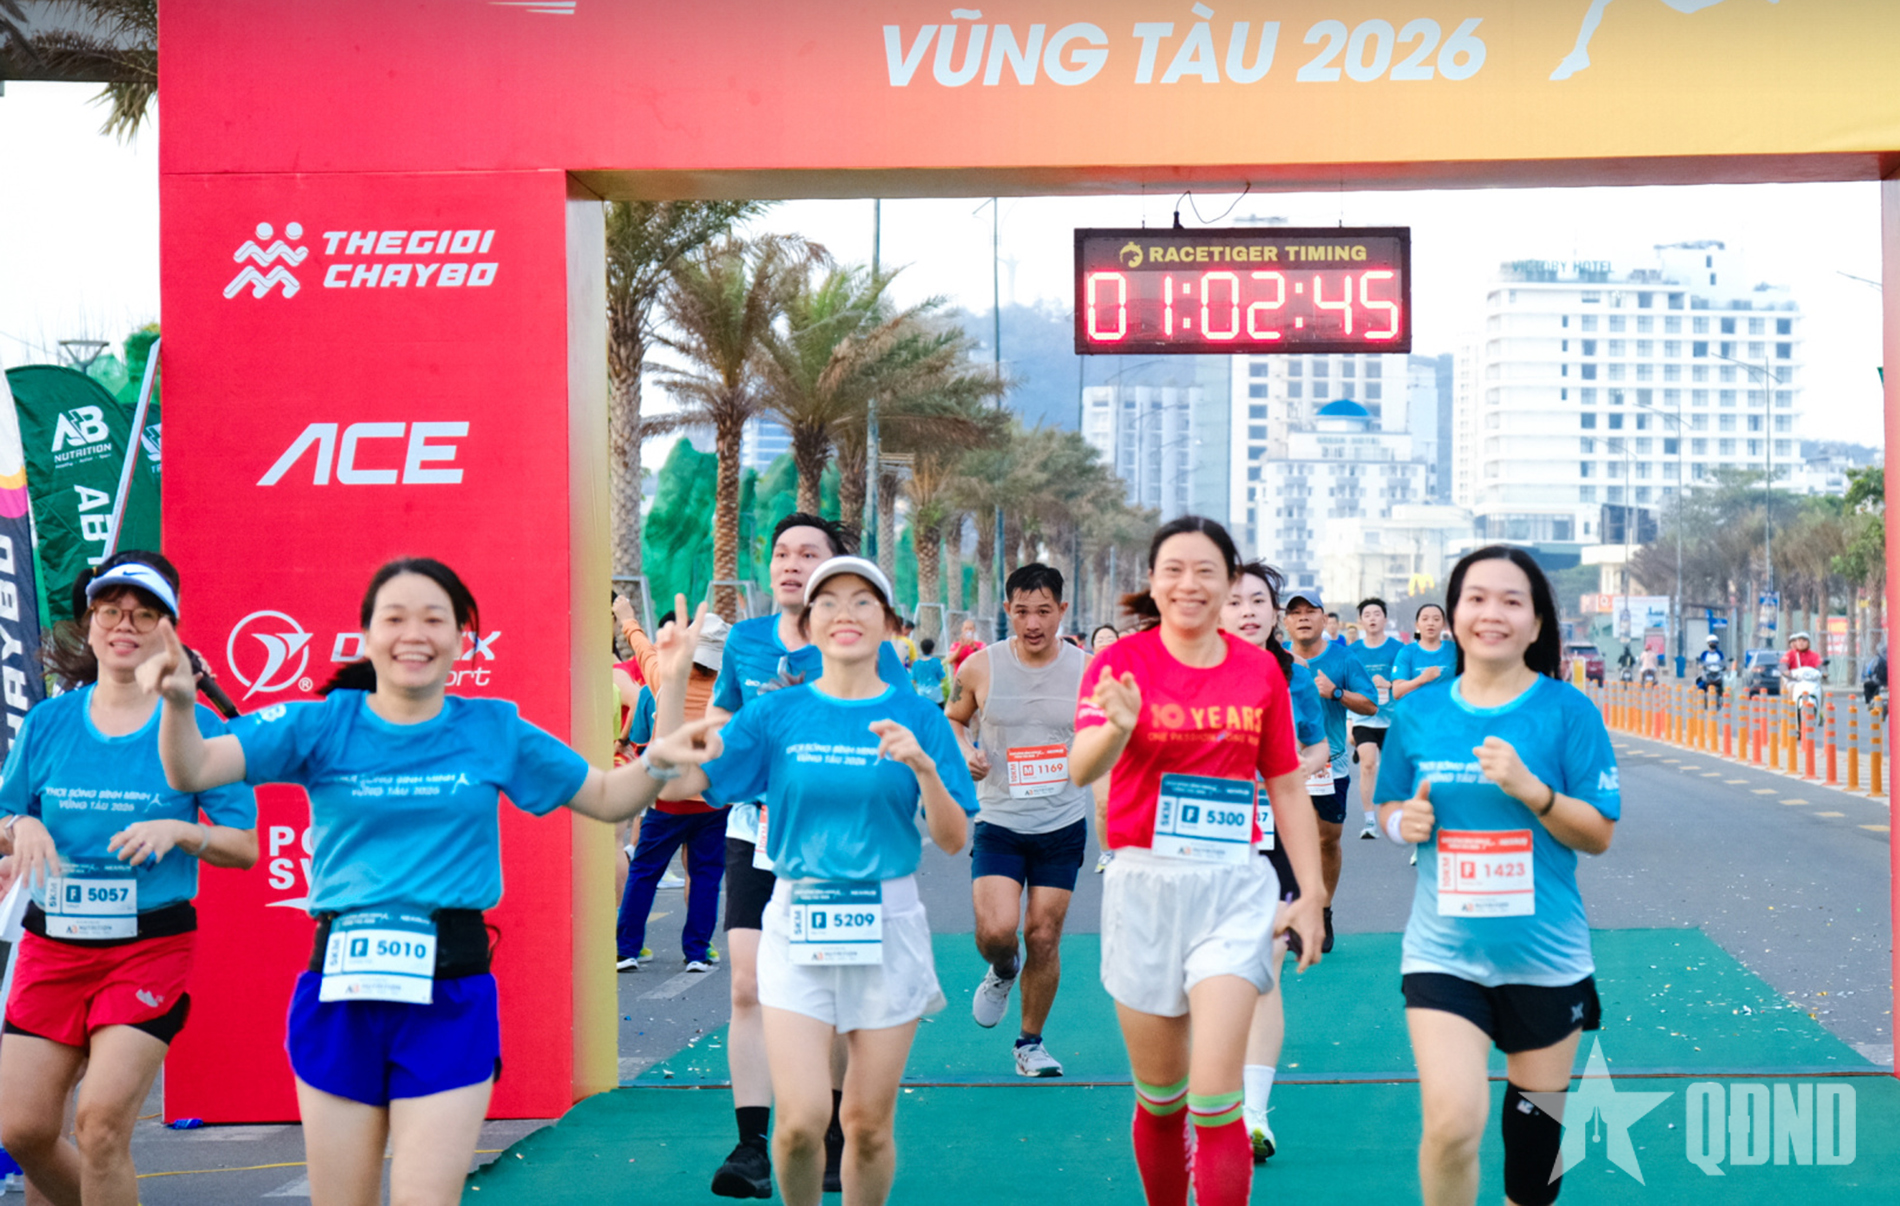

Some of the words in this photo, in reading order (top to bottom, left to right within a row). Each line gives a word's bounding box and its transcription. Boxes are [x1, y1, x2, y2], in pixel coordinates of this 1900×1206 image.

[883, 8, 1109, 87] VŨNG
[1132, 2, 1280, 84] TÀU
[1296, 18, 1487, 82] 2026
[322, 229, 495, 255] THEGIOI
[1149, 246, 1278, 263] RACETIGER
[1285, 245, 1367, 261] TIMING
[323, 263, 499, 288] CHAYBO
[1573, 261, 1613, 273] HOTEL
[1087, 270, 1398, 340] 01:02:45
[54, 443, 112, 463] NUTRITION
[256, 421, 469, 486] ACE
[1151, 703, 1185, 729] 10
[1038, 763, 1064, 774] 1169
[111, 803, 135, 811] 2026
[1207, 810, 1245, 826] 5300
[1485, 862, 1525, 878] 1423
[88, 888, 128, 901] 5057
[834, 913, 875, 927] 5209
[376, 940, 426, 959] 5010
